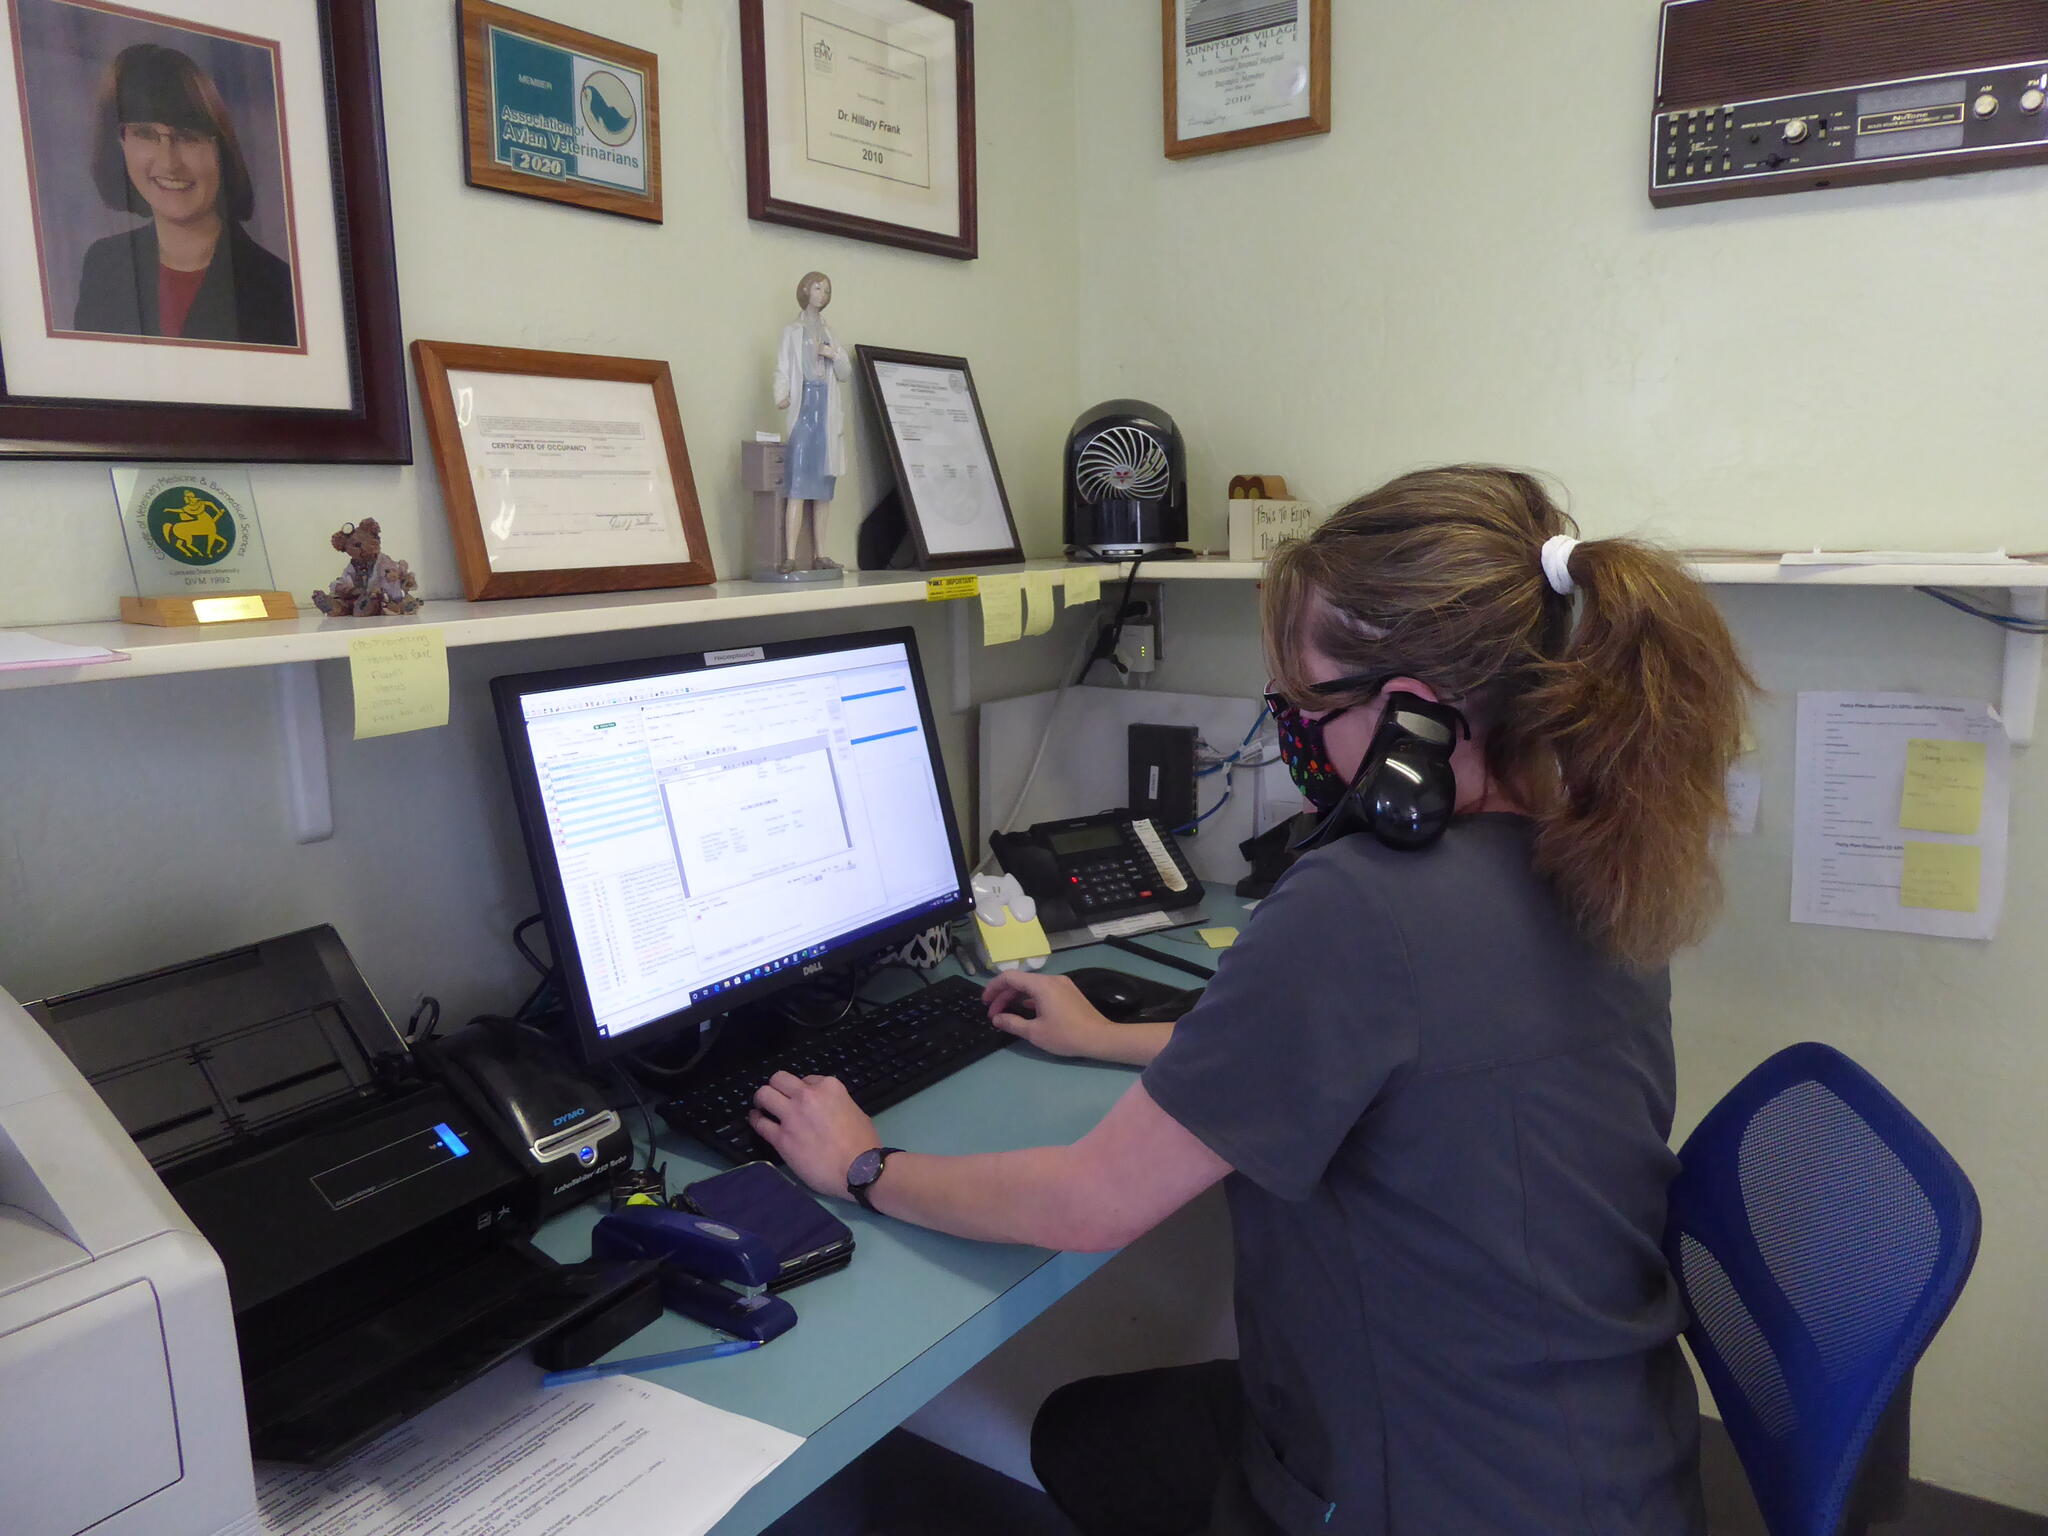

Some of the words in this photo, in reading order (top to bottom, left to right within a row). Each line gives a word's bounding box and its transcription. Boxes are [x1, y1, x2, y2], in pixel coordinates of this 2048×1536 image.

[1185, 38, 1250, 57] SUNNYSLOPE
[1224, 94, 1252, 106] 2010
[501, 104, 573, 137] Association
[574, 126, 585, 137] of
[838, 109, 850, 121] Dr.
[851, 112, 877, 131] Hillary
[879, 120, 901, 135] Frank
[503, 121, 547, 149] Avian
[547, 132, 639, 169] Veterinarians
[519, 152, 562, 175] 2020
[862, 148, 884, 164] 2010
[491, 441, 535, 452] CERTIFICATE
[536, 443, 546, 451] OF
[547, 443, 587, 453] OCCUPANCY
[803, 961, 823, 976] DELL
[553, 1108, 585, 1126] DYMO
[553, 1171, 595, 1195] LabelWriter
